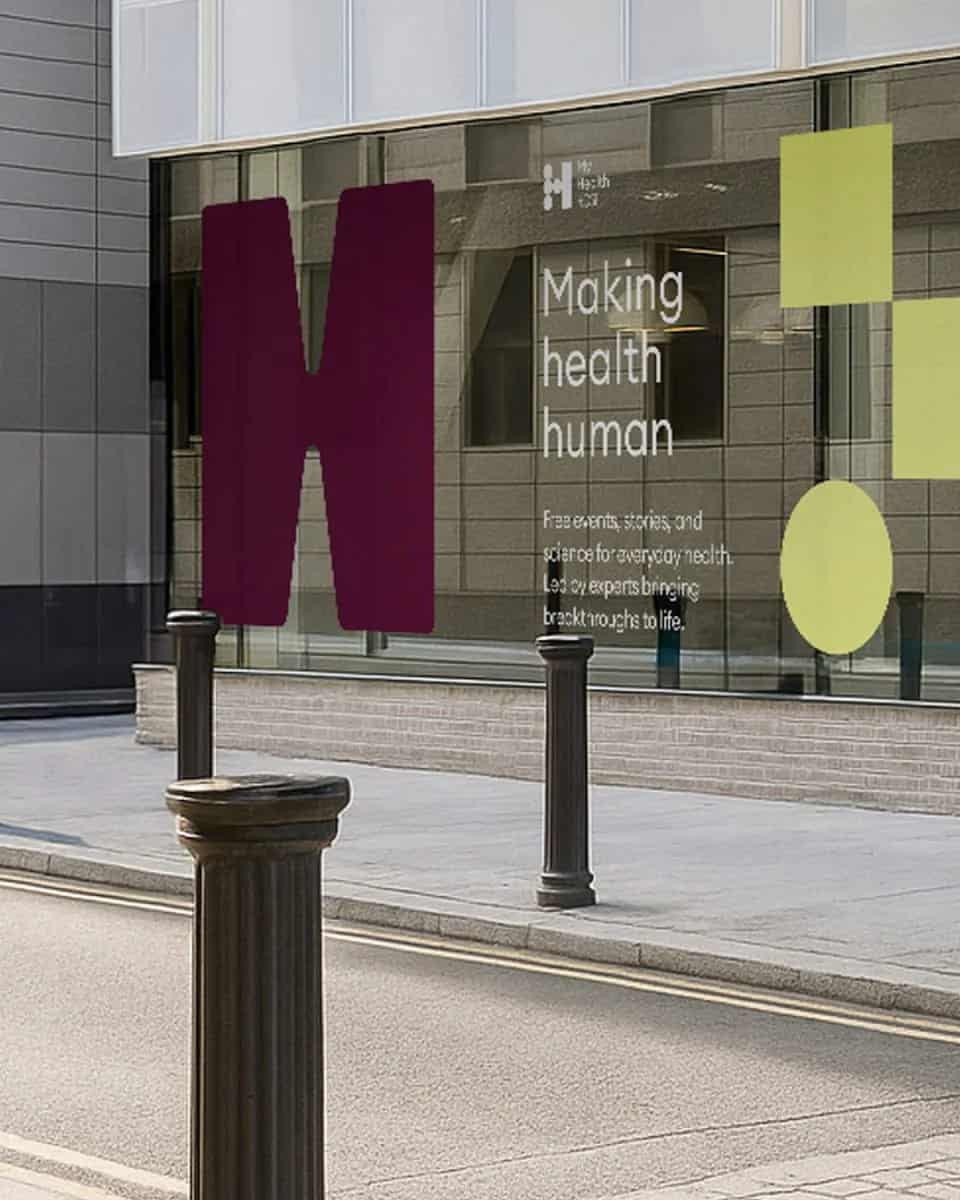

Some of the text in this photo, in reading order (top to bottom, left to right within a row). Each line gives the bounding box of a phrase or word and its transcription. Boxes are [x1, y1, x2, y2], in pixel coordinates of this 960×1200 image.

[543, 257, 683, 324] Making
[543, 329, 662, 387] health
[543, 406, 674, 458] human
[543, 509, 703, 534] Free events, stories, and
[543, 541, 734, 570] science for everyday health.
[543, 574, 699, 603] Led by experts bringing
[543, 606, 685, 633] breakthroughs to life.
